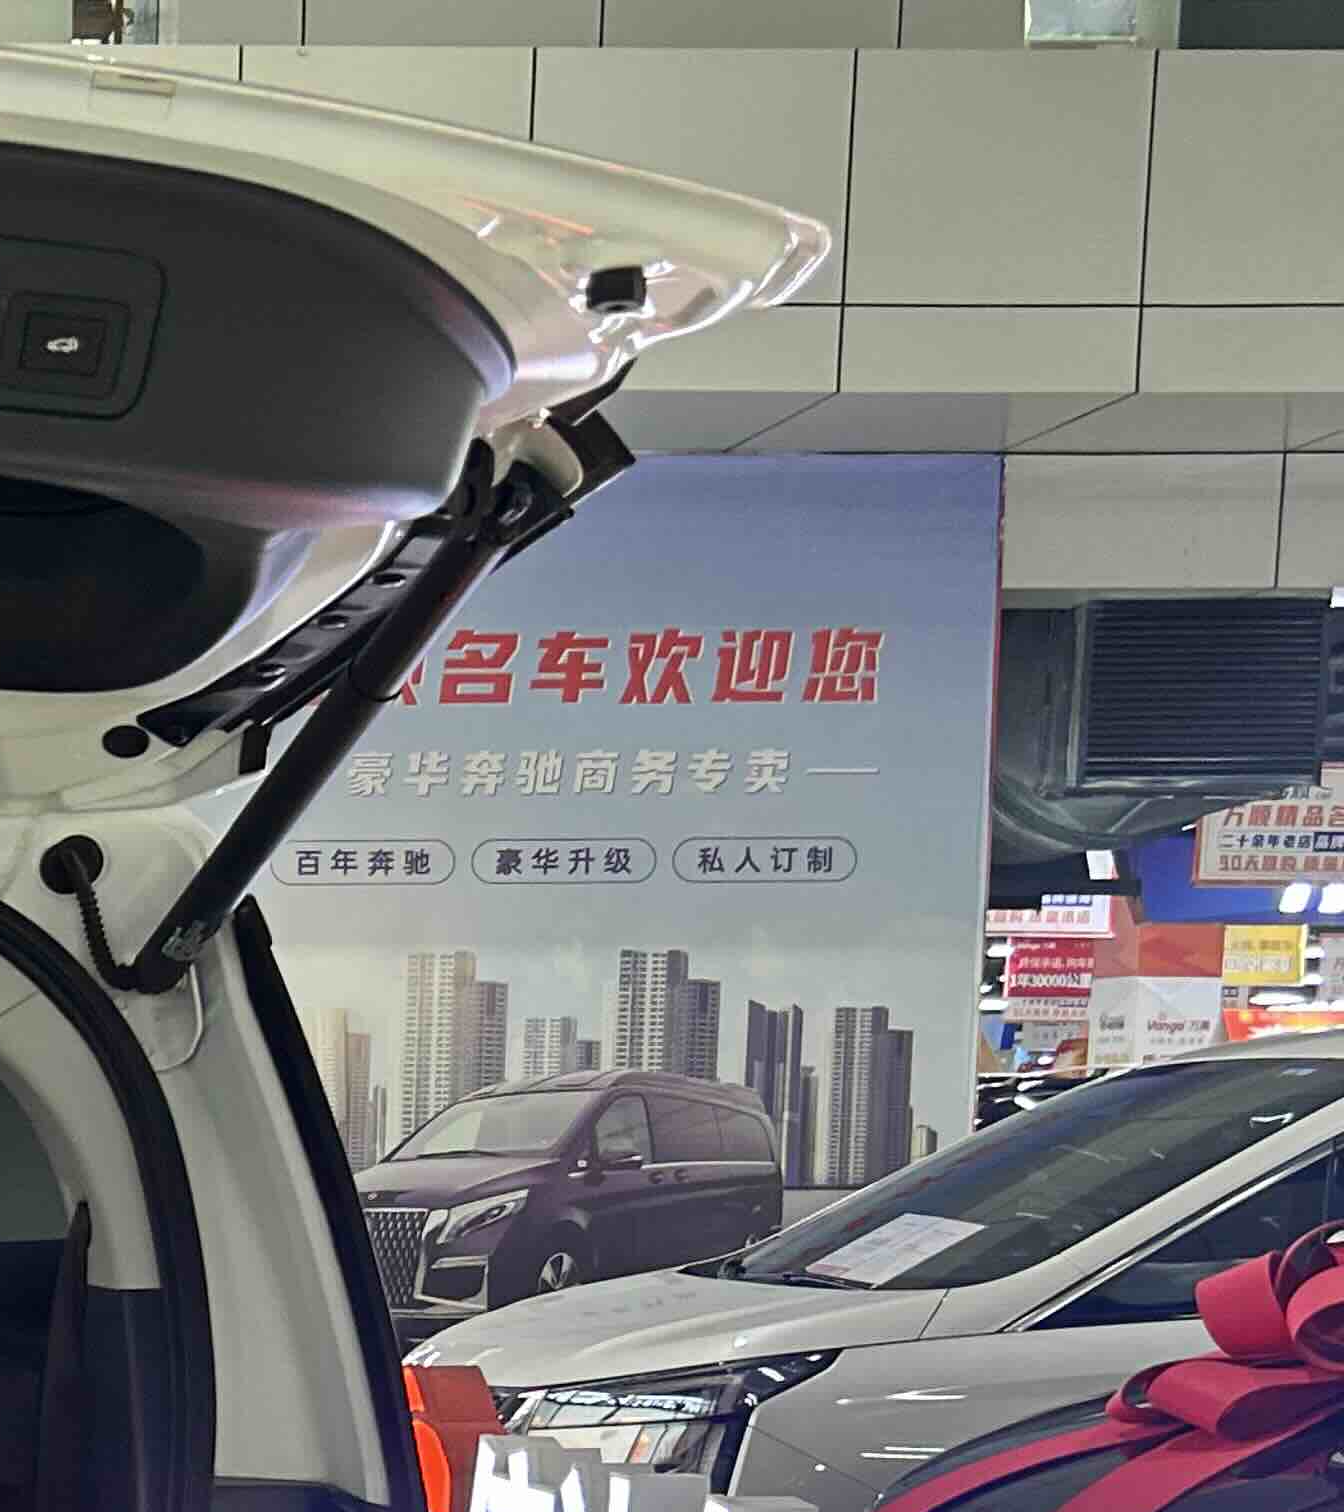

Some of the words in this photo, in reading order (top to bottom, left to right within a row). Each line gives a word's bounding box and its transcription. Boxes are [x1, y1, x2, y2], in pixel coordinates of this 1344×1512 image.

[397, 626, 885, 705] 名车欢迎您
[346, 752, 792, 797] 豪华奔驰商务专卖
[295, 850, 432, 876] 百年奔驰
[495, 848, 633, 876] 豪华升级
[697, 846, 834, 875] 私人订制
